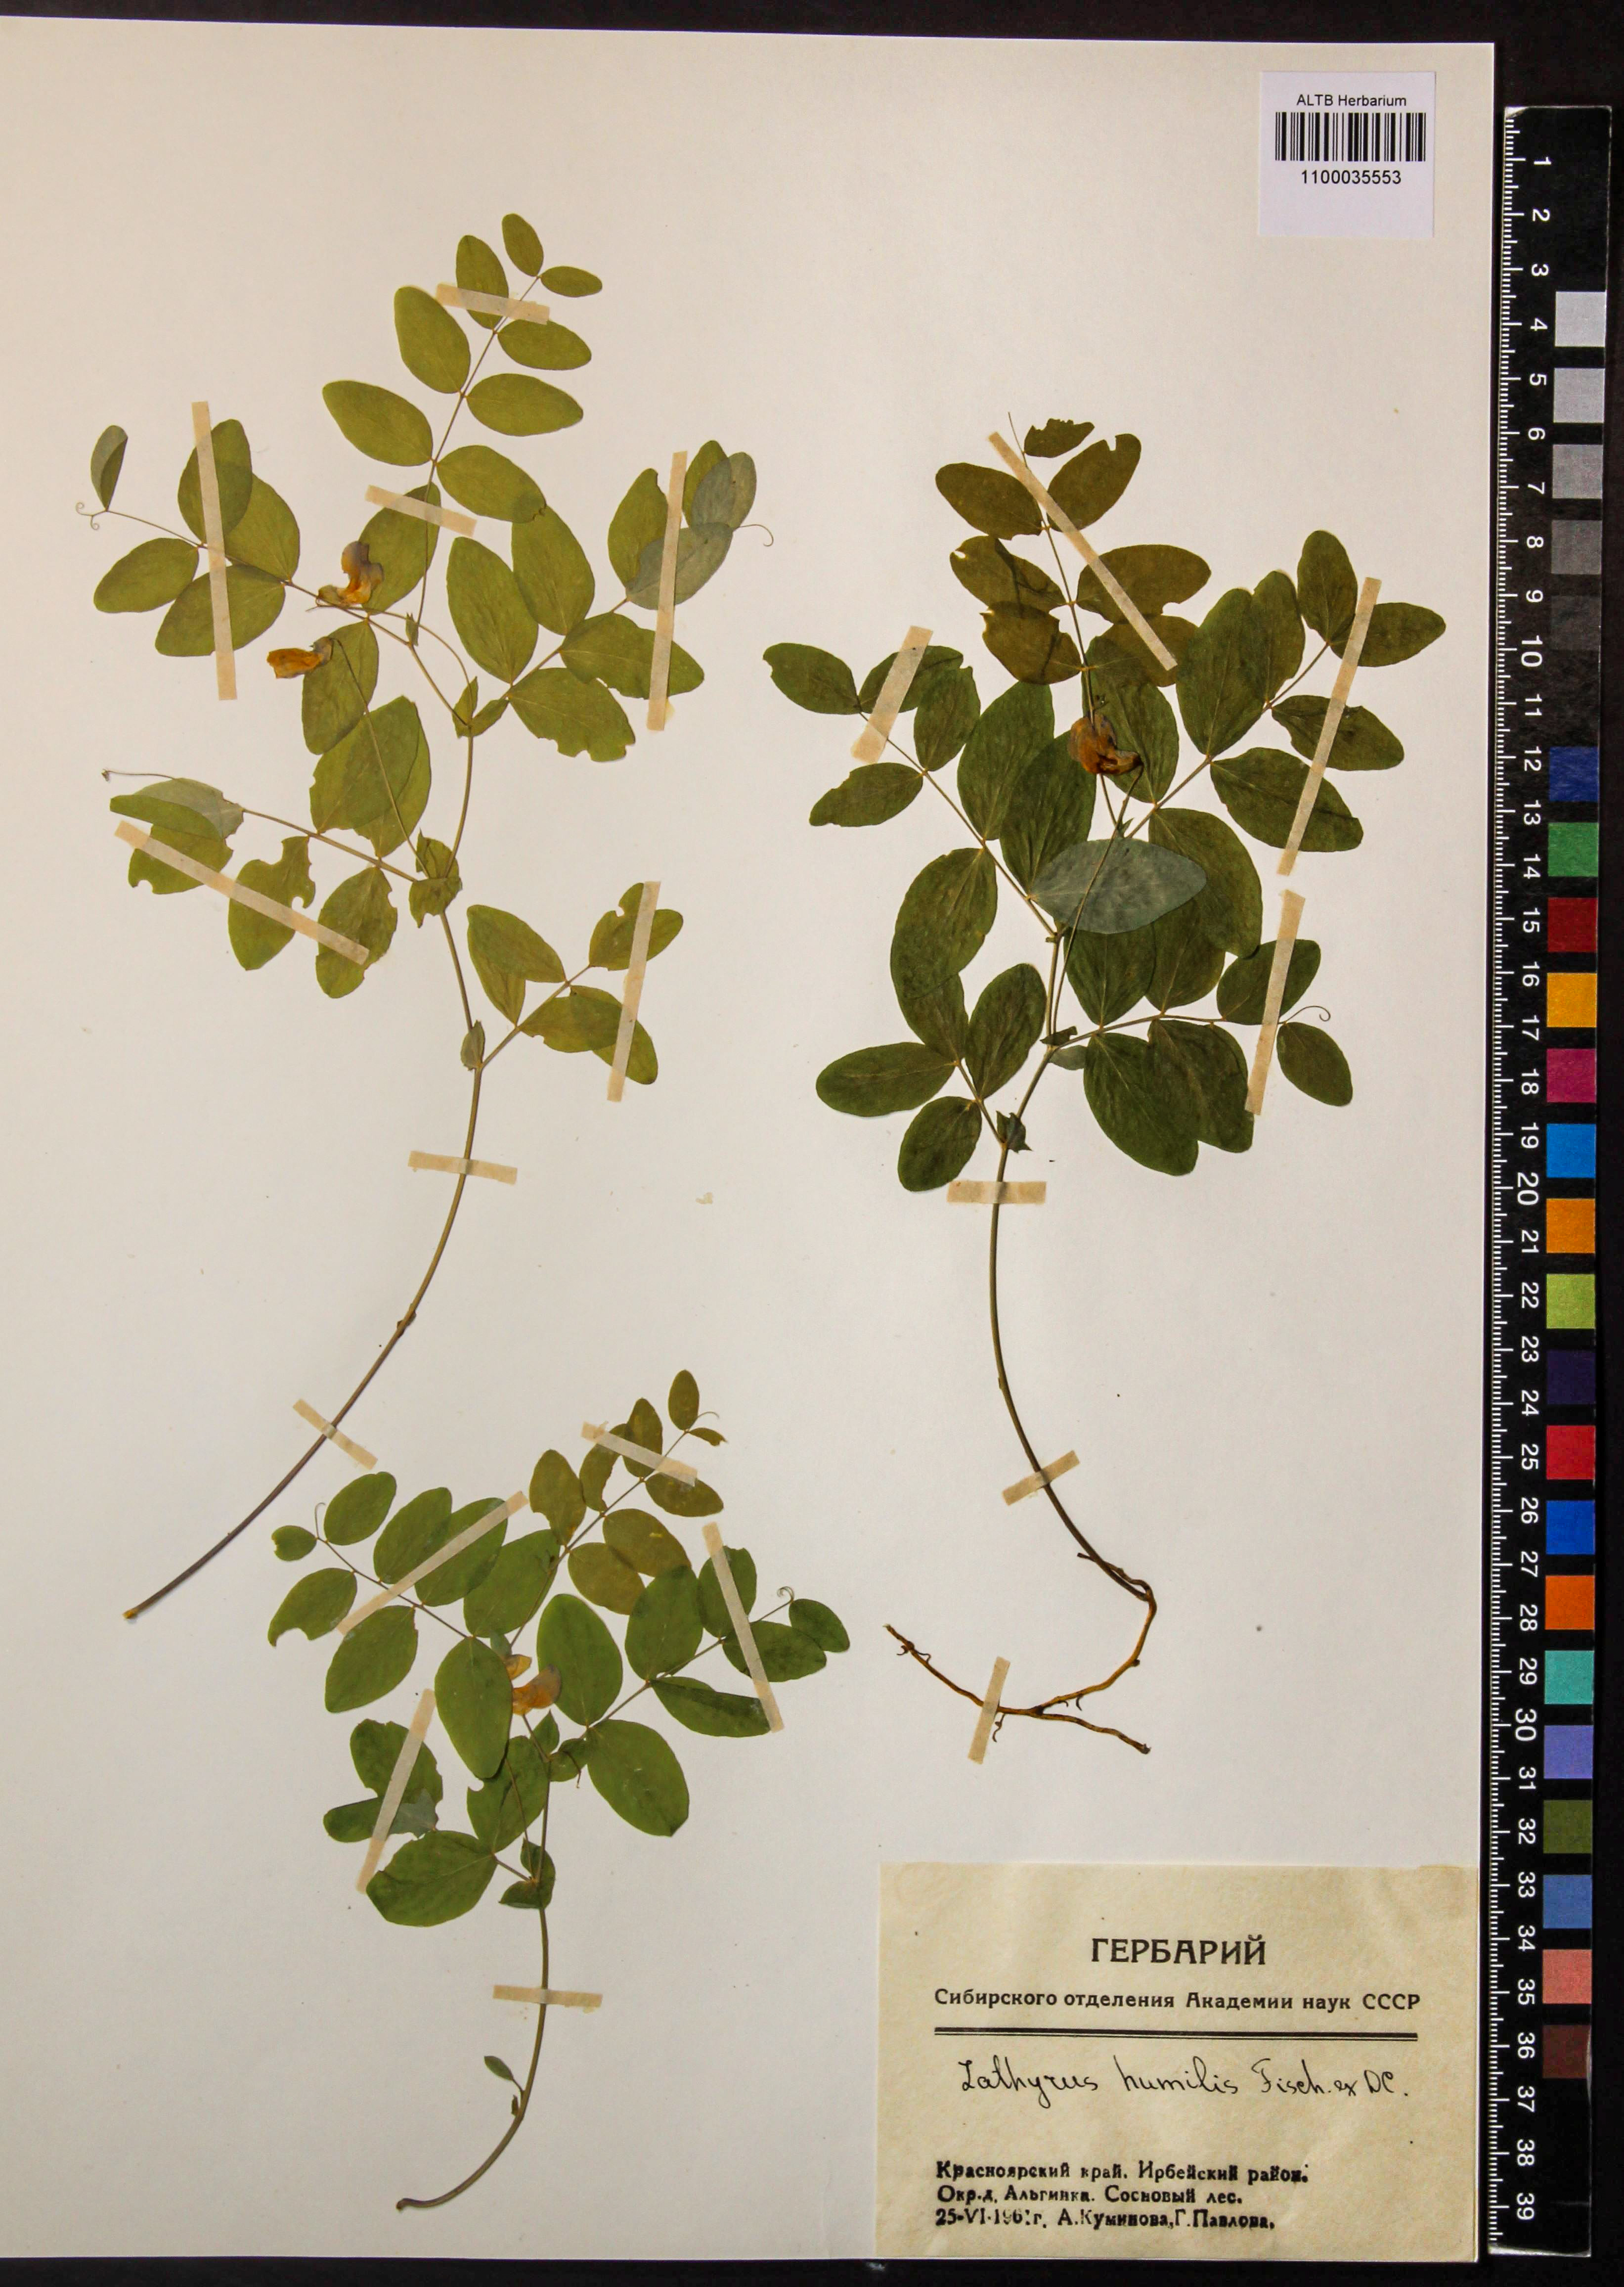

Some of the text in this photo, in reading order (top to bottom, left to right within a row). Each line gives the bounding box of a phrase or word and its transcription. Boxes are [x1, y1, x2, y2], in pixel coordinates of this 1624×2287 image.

[1296, 94, 1406, 106] ALTB Herbarium
[1301, 169, 1402, 184] 1100035553
[1515, 157, 1552, 2220] 1 2 3 4 5 6 7 8 9 10 11 12 13 14 15 16 17 18 19 20 21 22 23 24 25 26 27 28 29 30 31 32 33 34 35 36 37 38 39
[1091, 1934, 1267, 1966] ГЕРБАРИЙ
[934, 1988, 1420, 2013] Сибирского отделения Академии наук СССР
[958, 2055, 1098, 2108] Lathyrus
[1113, 2055, 1238, 2095] humilis
[936, 2160, 1070, 2182] Красноярский
[1081, 2163, 1128, 2182] край.
[1139, 2160, 1238, 2183] Ирбейский
[1105, 2185, 1196, 2203] Сосновый
[1206, 2192, 1242, 2204] лес.
